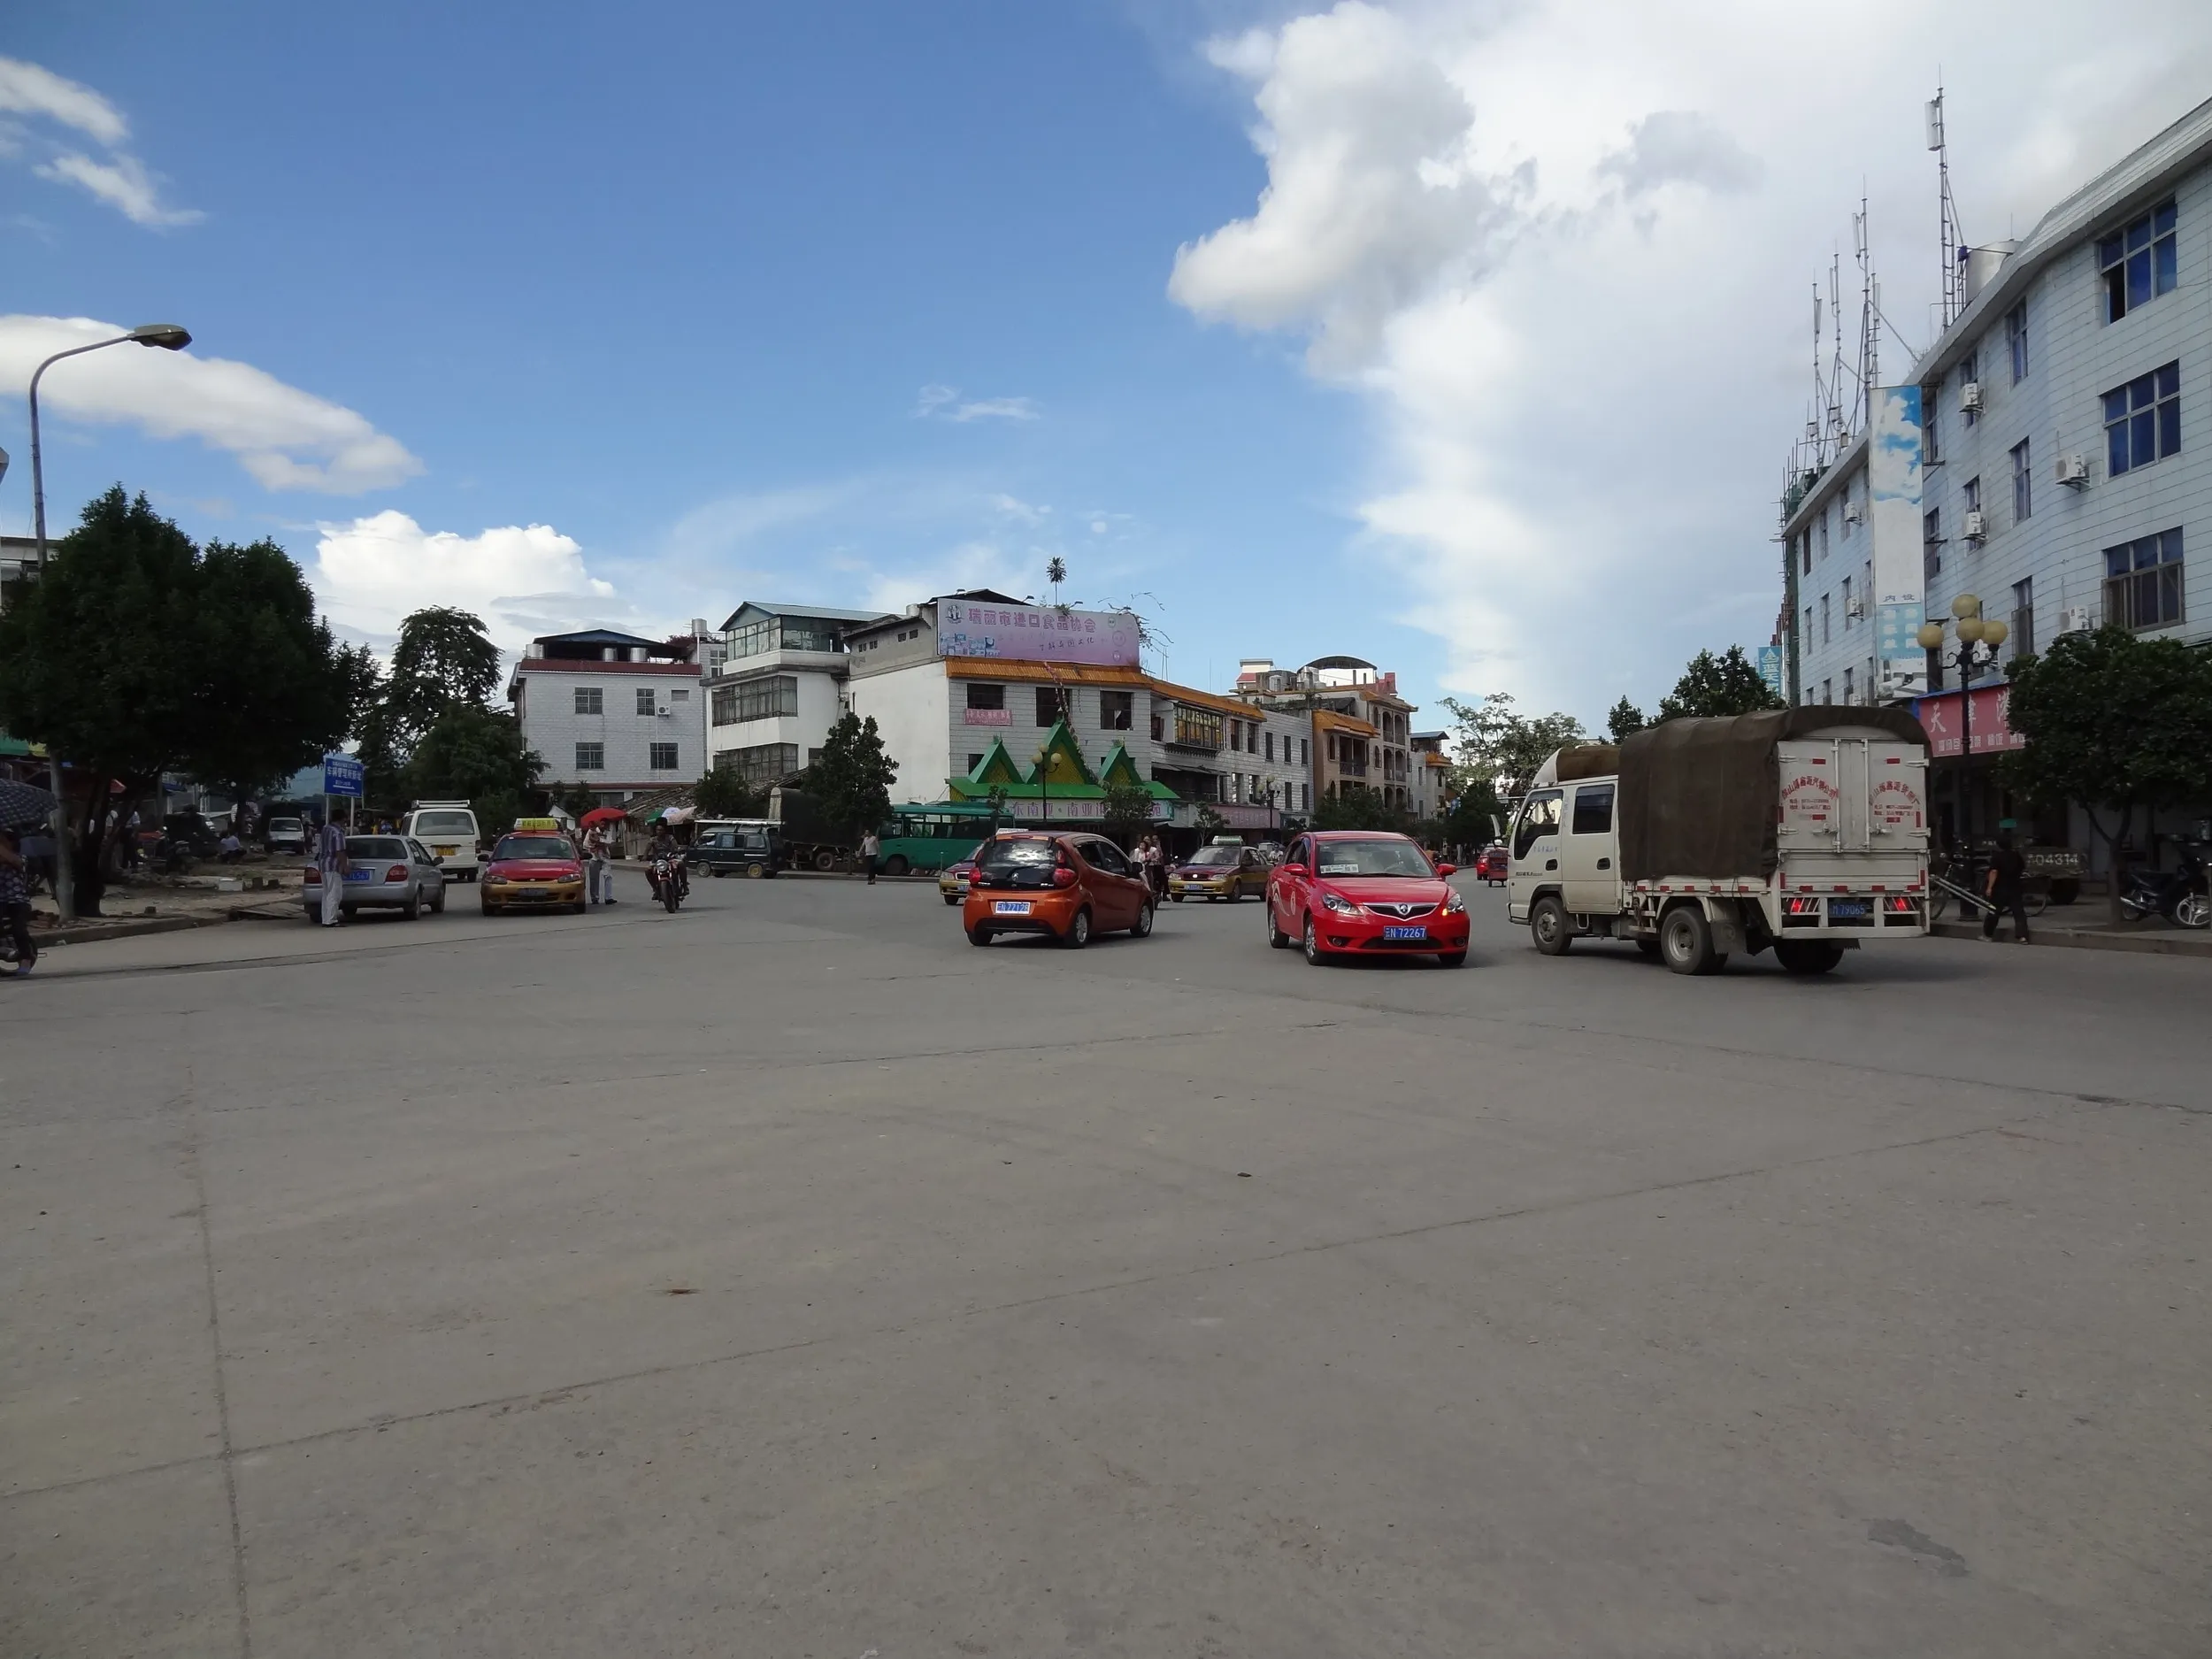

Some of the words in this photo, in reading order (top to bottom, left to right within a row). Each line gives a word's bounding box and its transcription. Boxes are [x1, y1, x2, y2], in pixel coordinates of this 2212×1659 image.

[968, 607, 1096, 634] 瑞丽市进口食品协会
[1385, 927, 1426, 939] 云N72267
